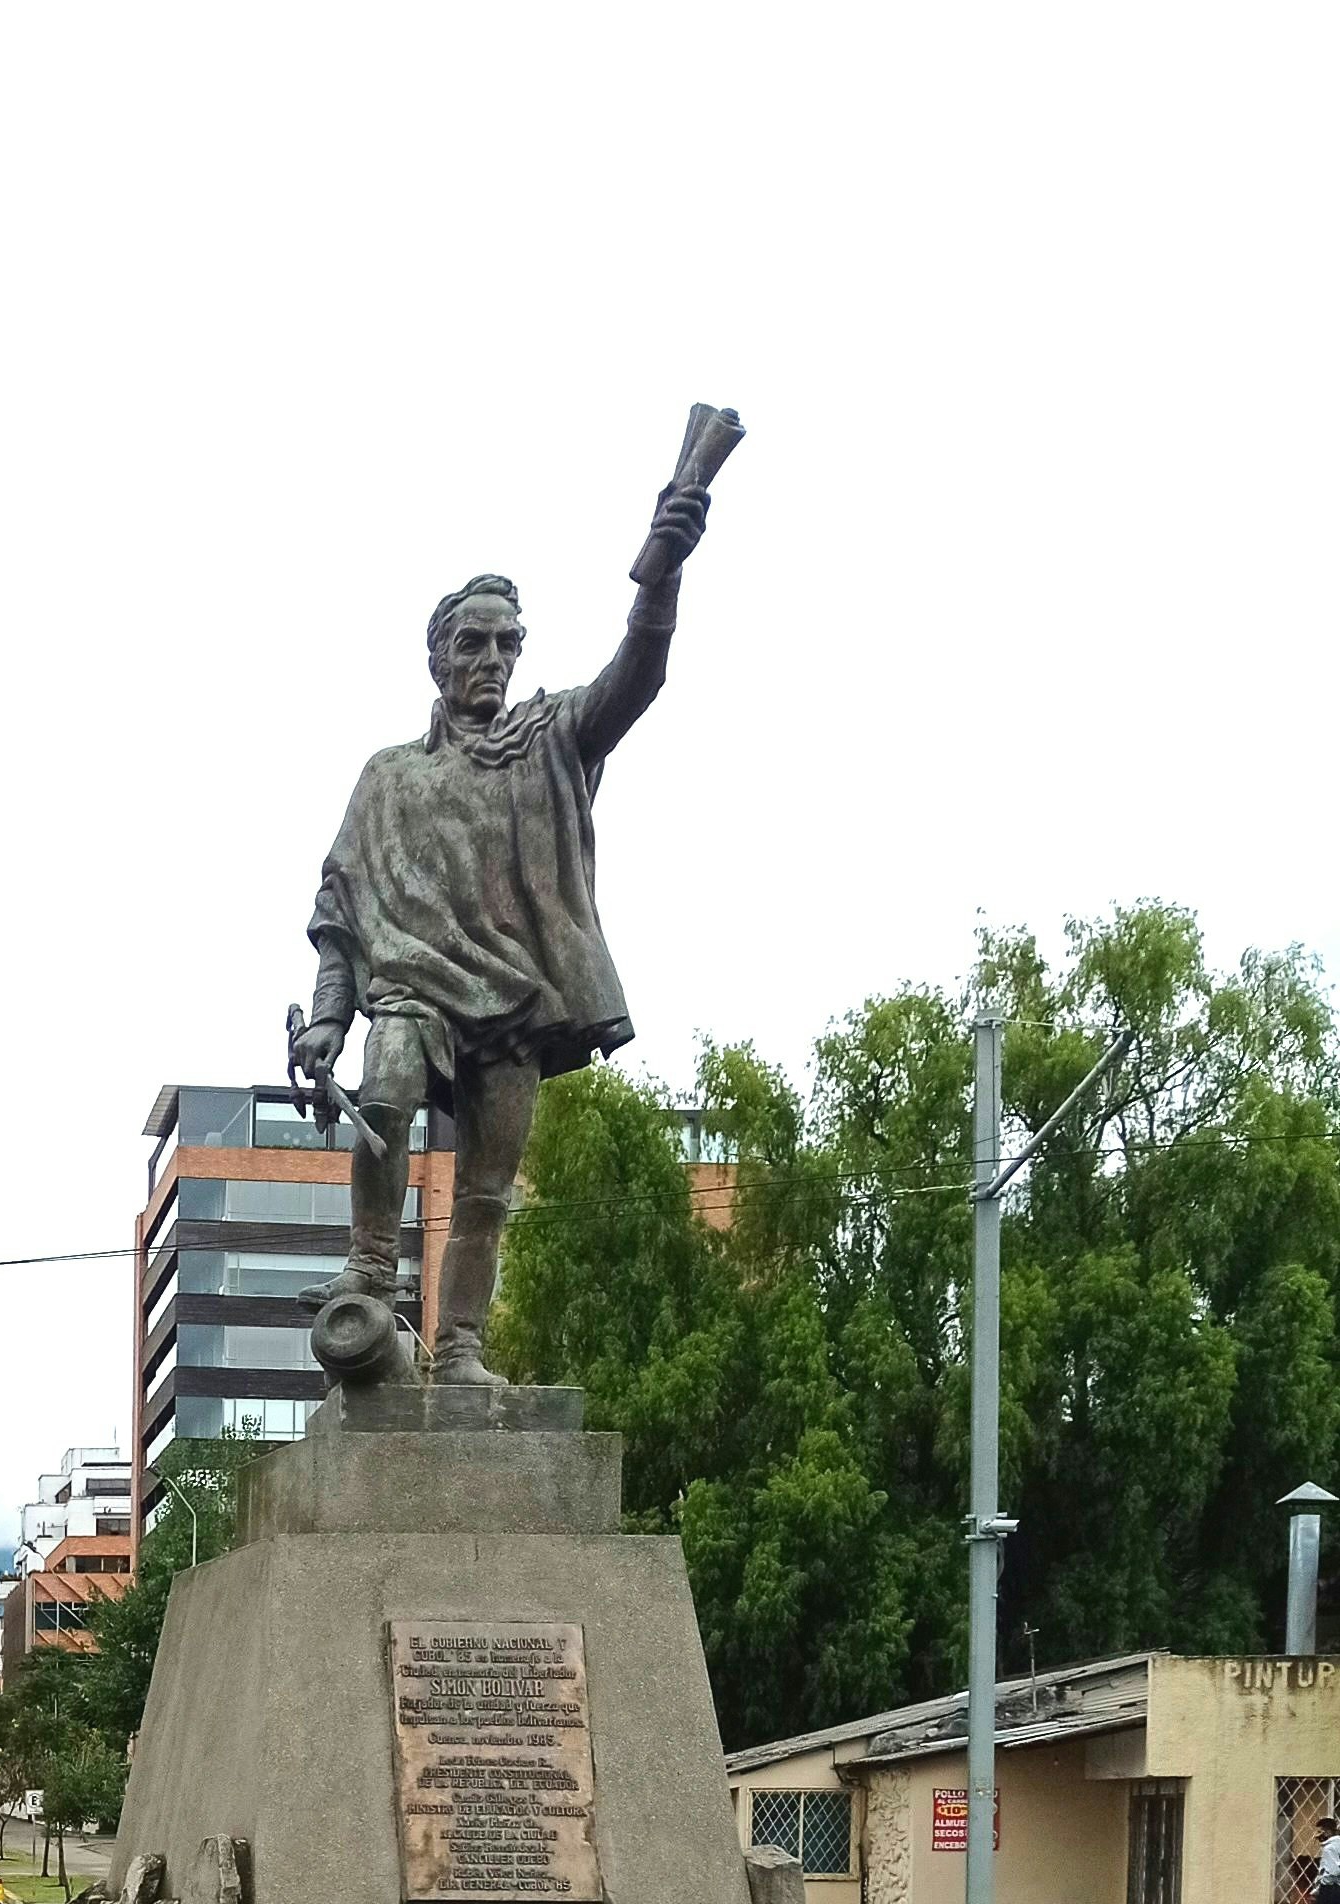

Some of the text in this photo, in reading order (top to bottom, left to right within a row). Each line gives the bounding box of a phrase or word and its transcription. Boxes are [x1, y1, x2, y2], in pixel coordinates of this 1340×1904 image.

[410, 1637, 426, 1649] EL
[430, 1637, 488, 1650] GOBIERNO
[493, 1638, 553, 1650] NACIONAL
[935, 1790, 965, 1798] POLLO
